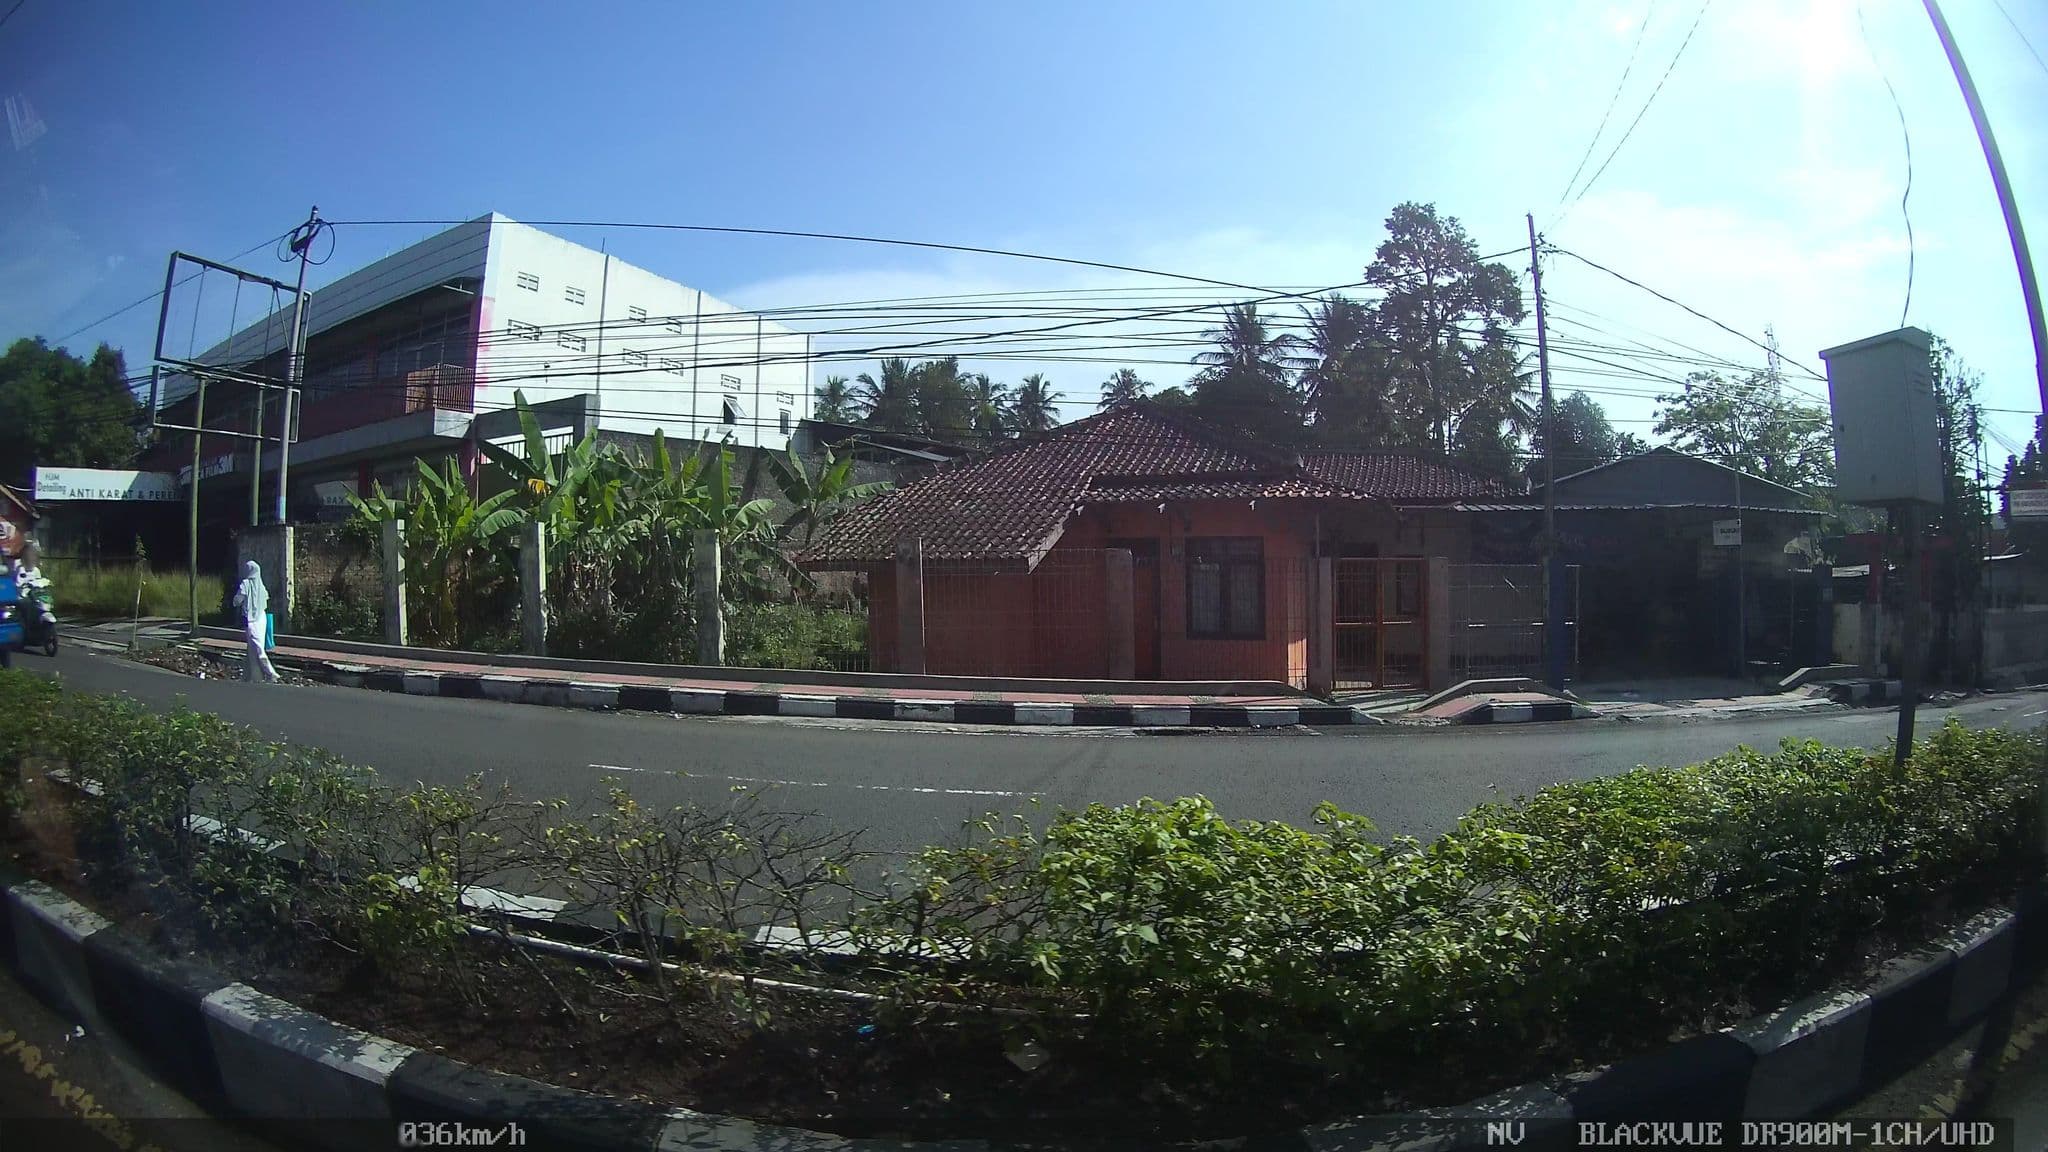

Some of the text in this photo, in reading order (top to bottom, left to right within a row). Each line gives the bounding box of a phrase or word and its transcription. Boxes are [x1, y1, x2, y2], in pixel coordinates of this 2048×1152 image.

[69, 488, 95, 498] ANTI
[99, 489, 134, 499] KARAT
[138, 490, 144, 499] &
